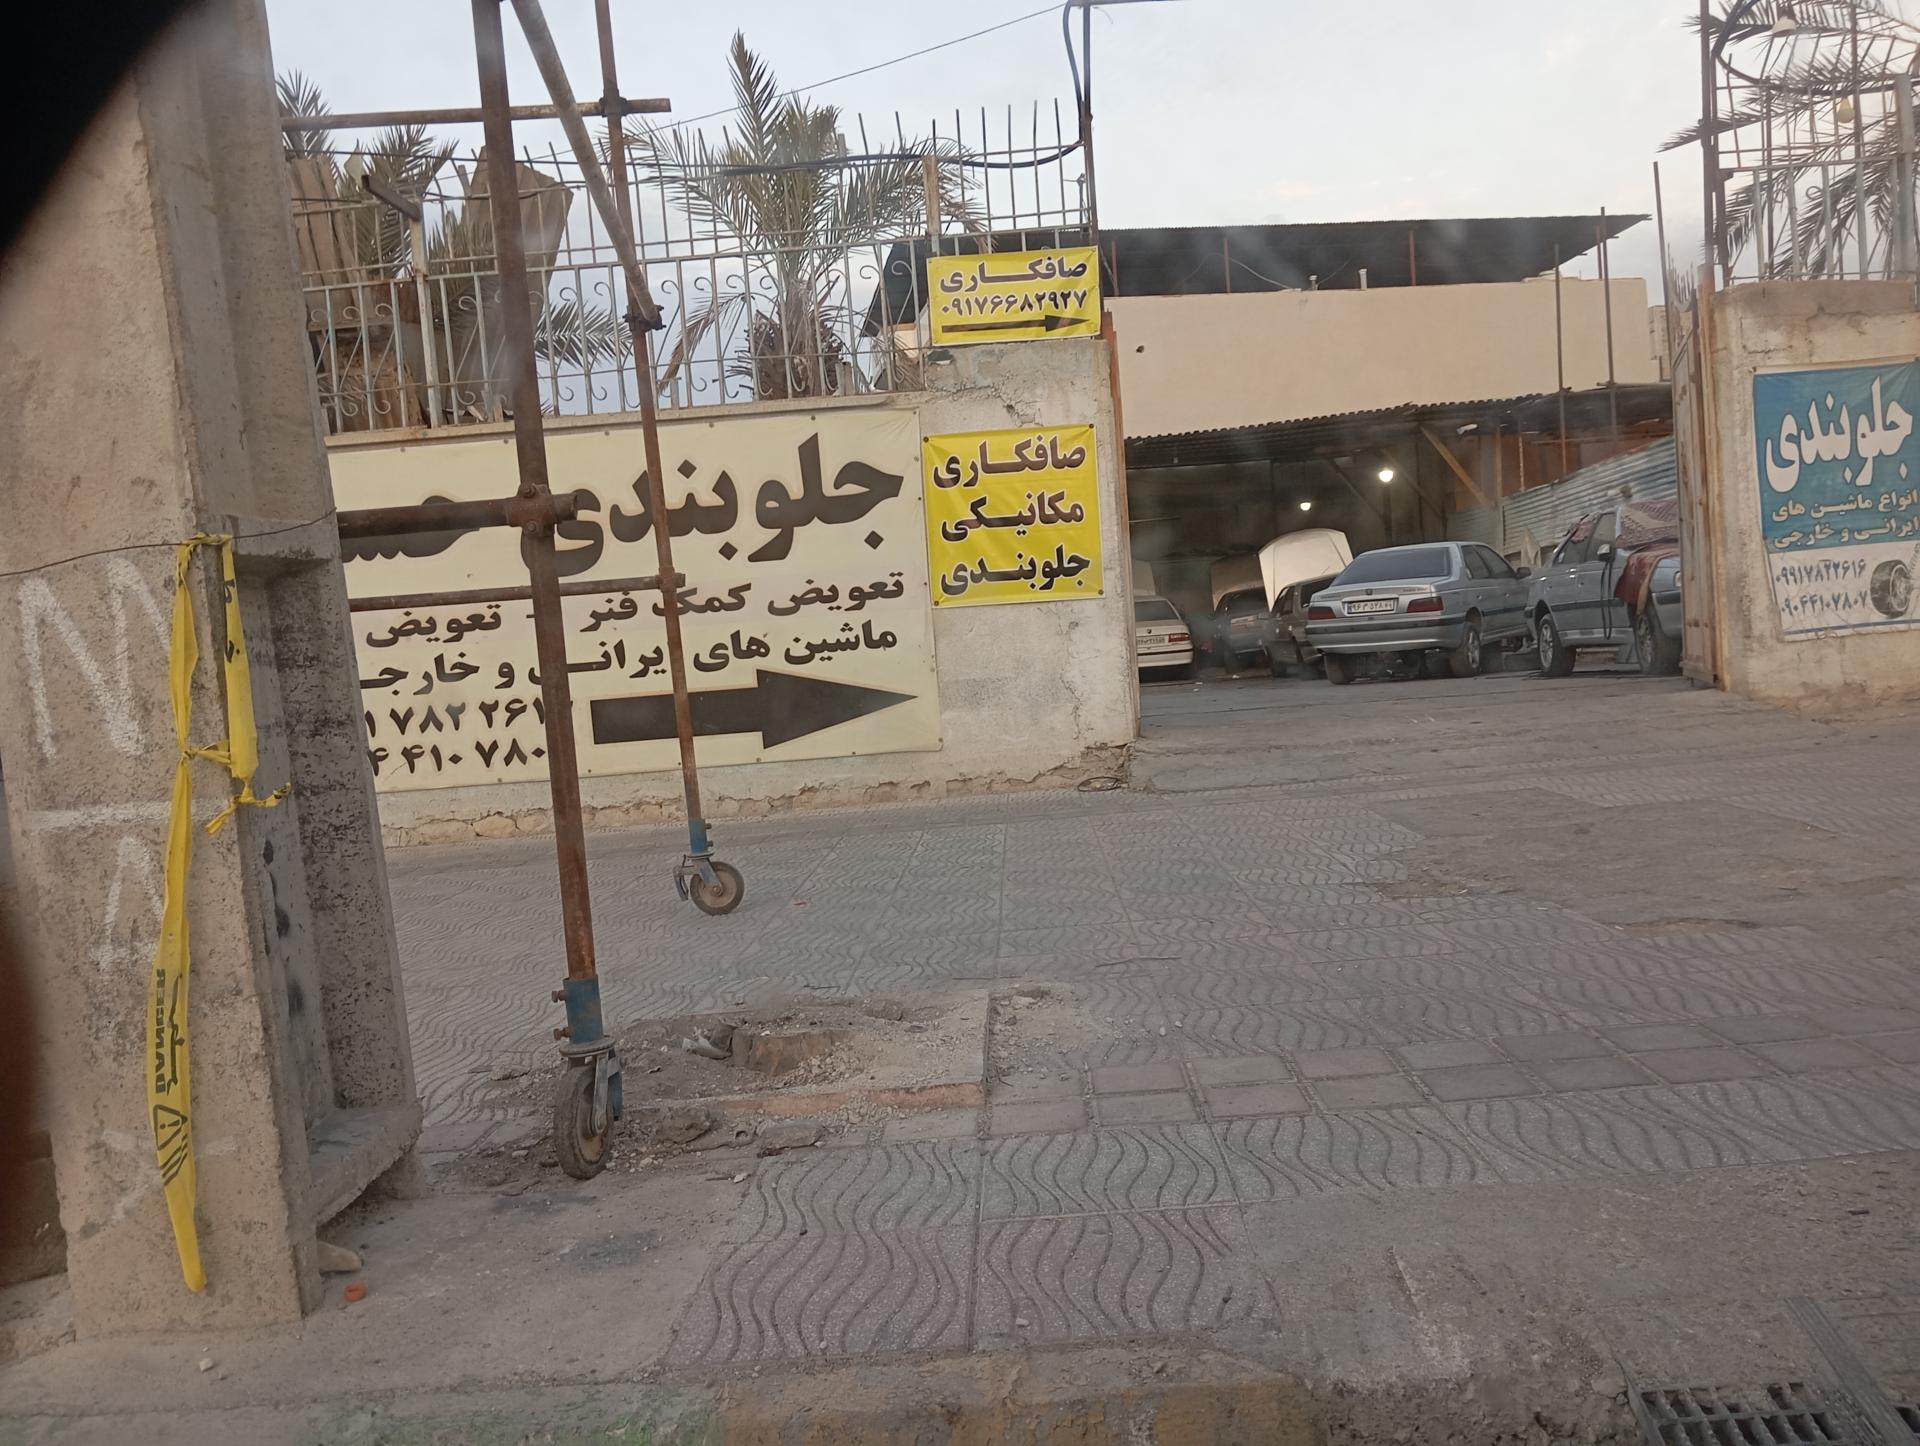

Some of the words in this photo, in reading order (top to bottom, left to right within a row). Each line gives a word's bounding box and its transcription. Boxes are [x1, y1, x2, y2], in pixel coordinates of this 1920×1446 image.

[940, 256, 1088, 294] صافکاری
[1765, 376, 1914, 493] جلوبندی
[933, 435, 1086, 488] صافکاری
[521, 432, 905, 577] جلوبندی
[941, 490, 1085, 542] مکانیکی
[1772, 499, 1806, 522] های
[1774, 523, 1836, 548] خارجی
[1840, 528, 1850, 542] و
[940, 544, 1091, 596] جلوبندی
[579, 590, 638, 633] فنر
[652, 582, 752, 616] کمک
[768, 571, 904, 616] تعویض
[366, 603, 502, 648] تعویض
[784, 619, 898, 665] ماشین
[693, 629, 771, 672] های
[360, 651, 480, 697] خارج
[495, 661, 515, 690] و
